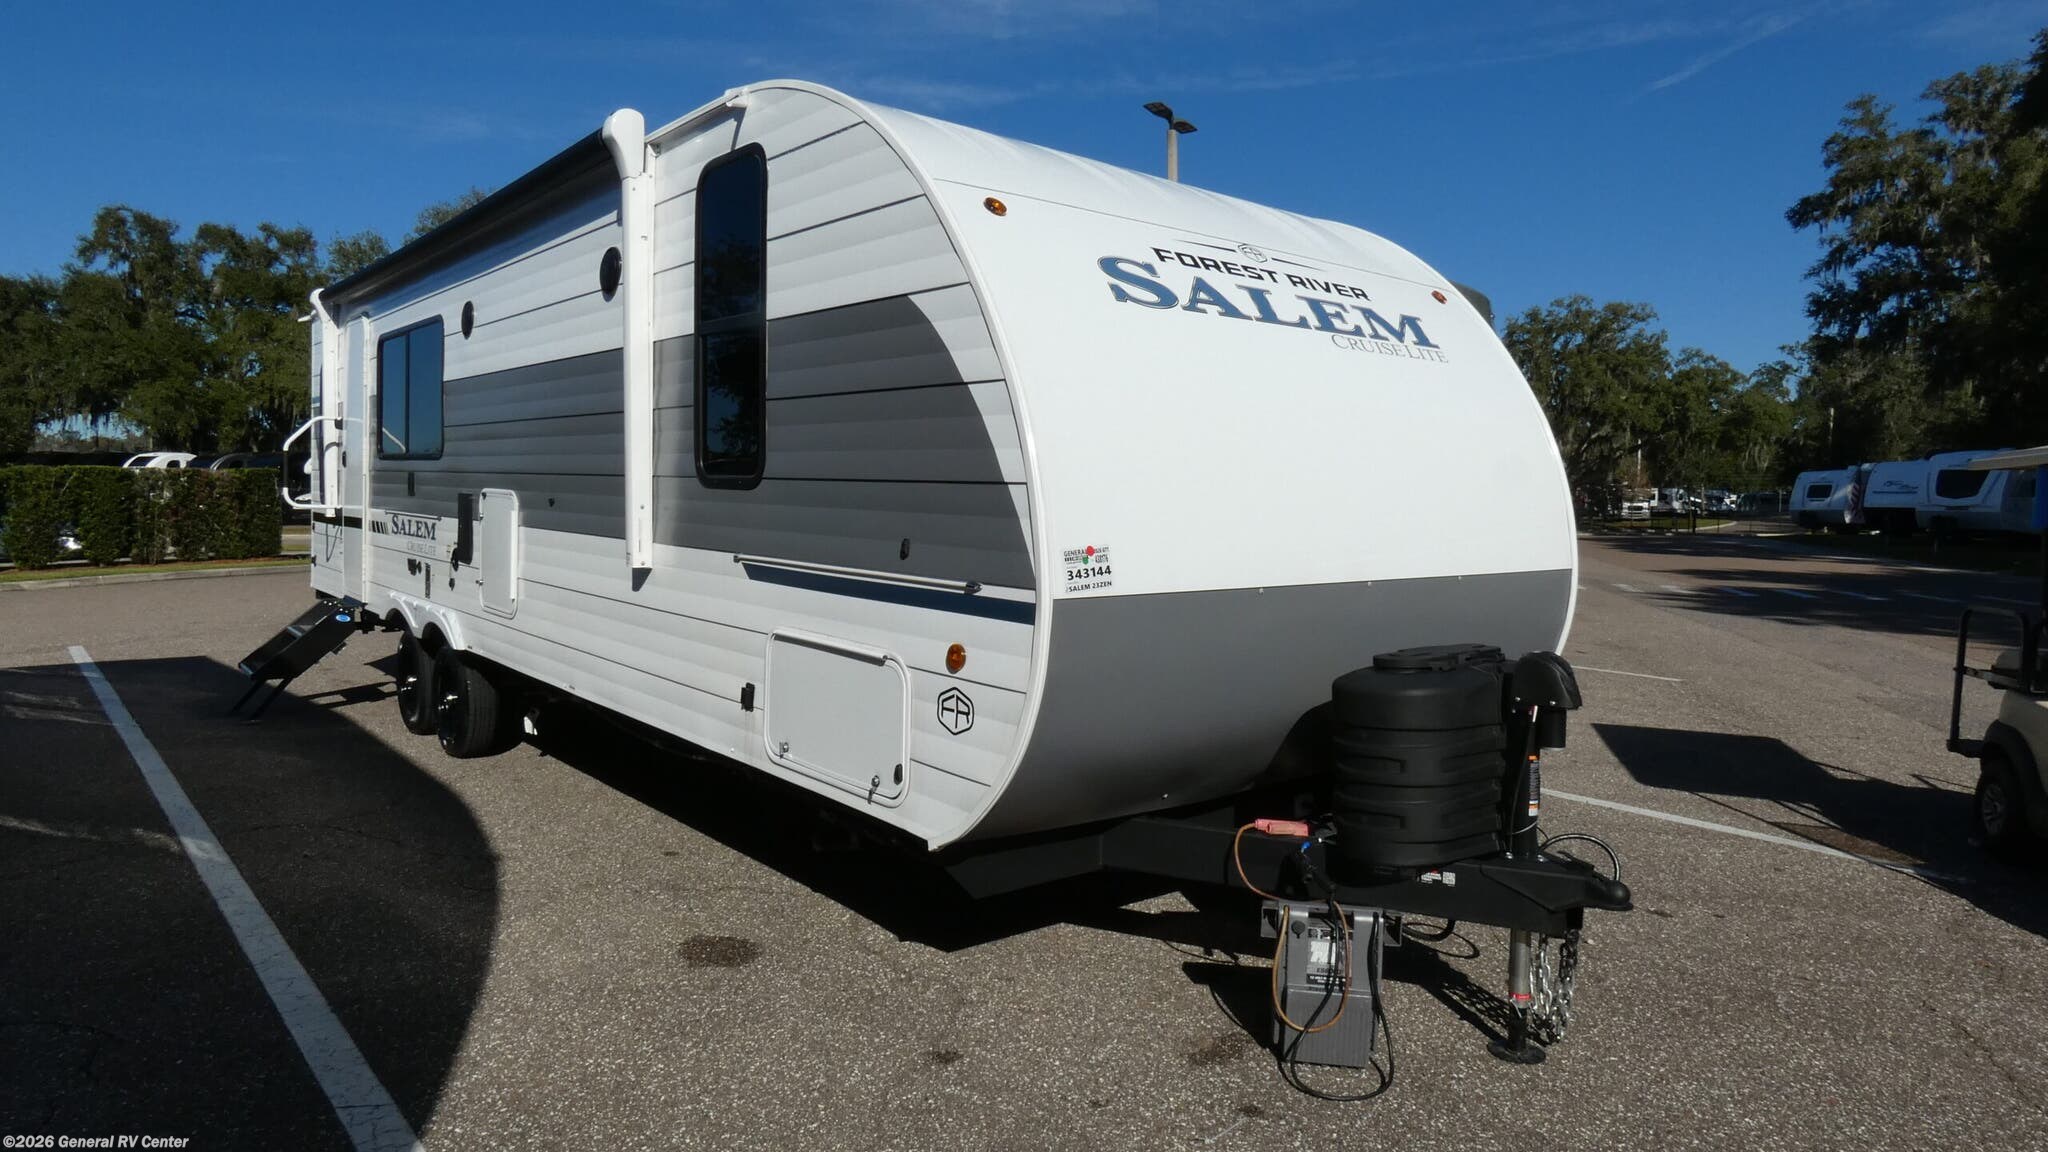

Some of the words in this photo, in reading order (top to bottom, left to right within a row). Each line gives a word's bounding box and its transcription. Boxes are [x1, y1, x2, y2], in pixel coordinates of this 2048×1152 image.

[1150, 246, 1277, 282] FOREST
[1284, 272, 1370, 301] RIVER
[1097, 254, 1440, 349] SALEM
[1331, 334, 1449, 364] CRUISELITE
[391, 513, 436, 541] SALEM
[1067, 565, 1112, 581] 343144
[1069, 583, 1090, 592] SALEM
